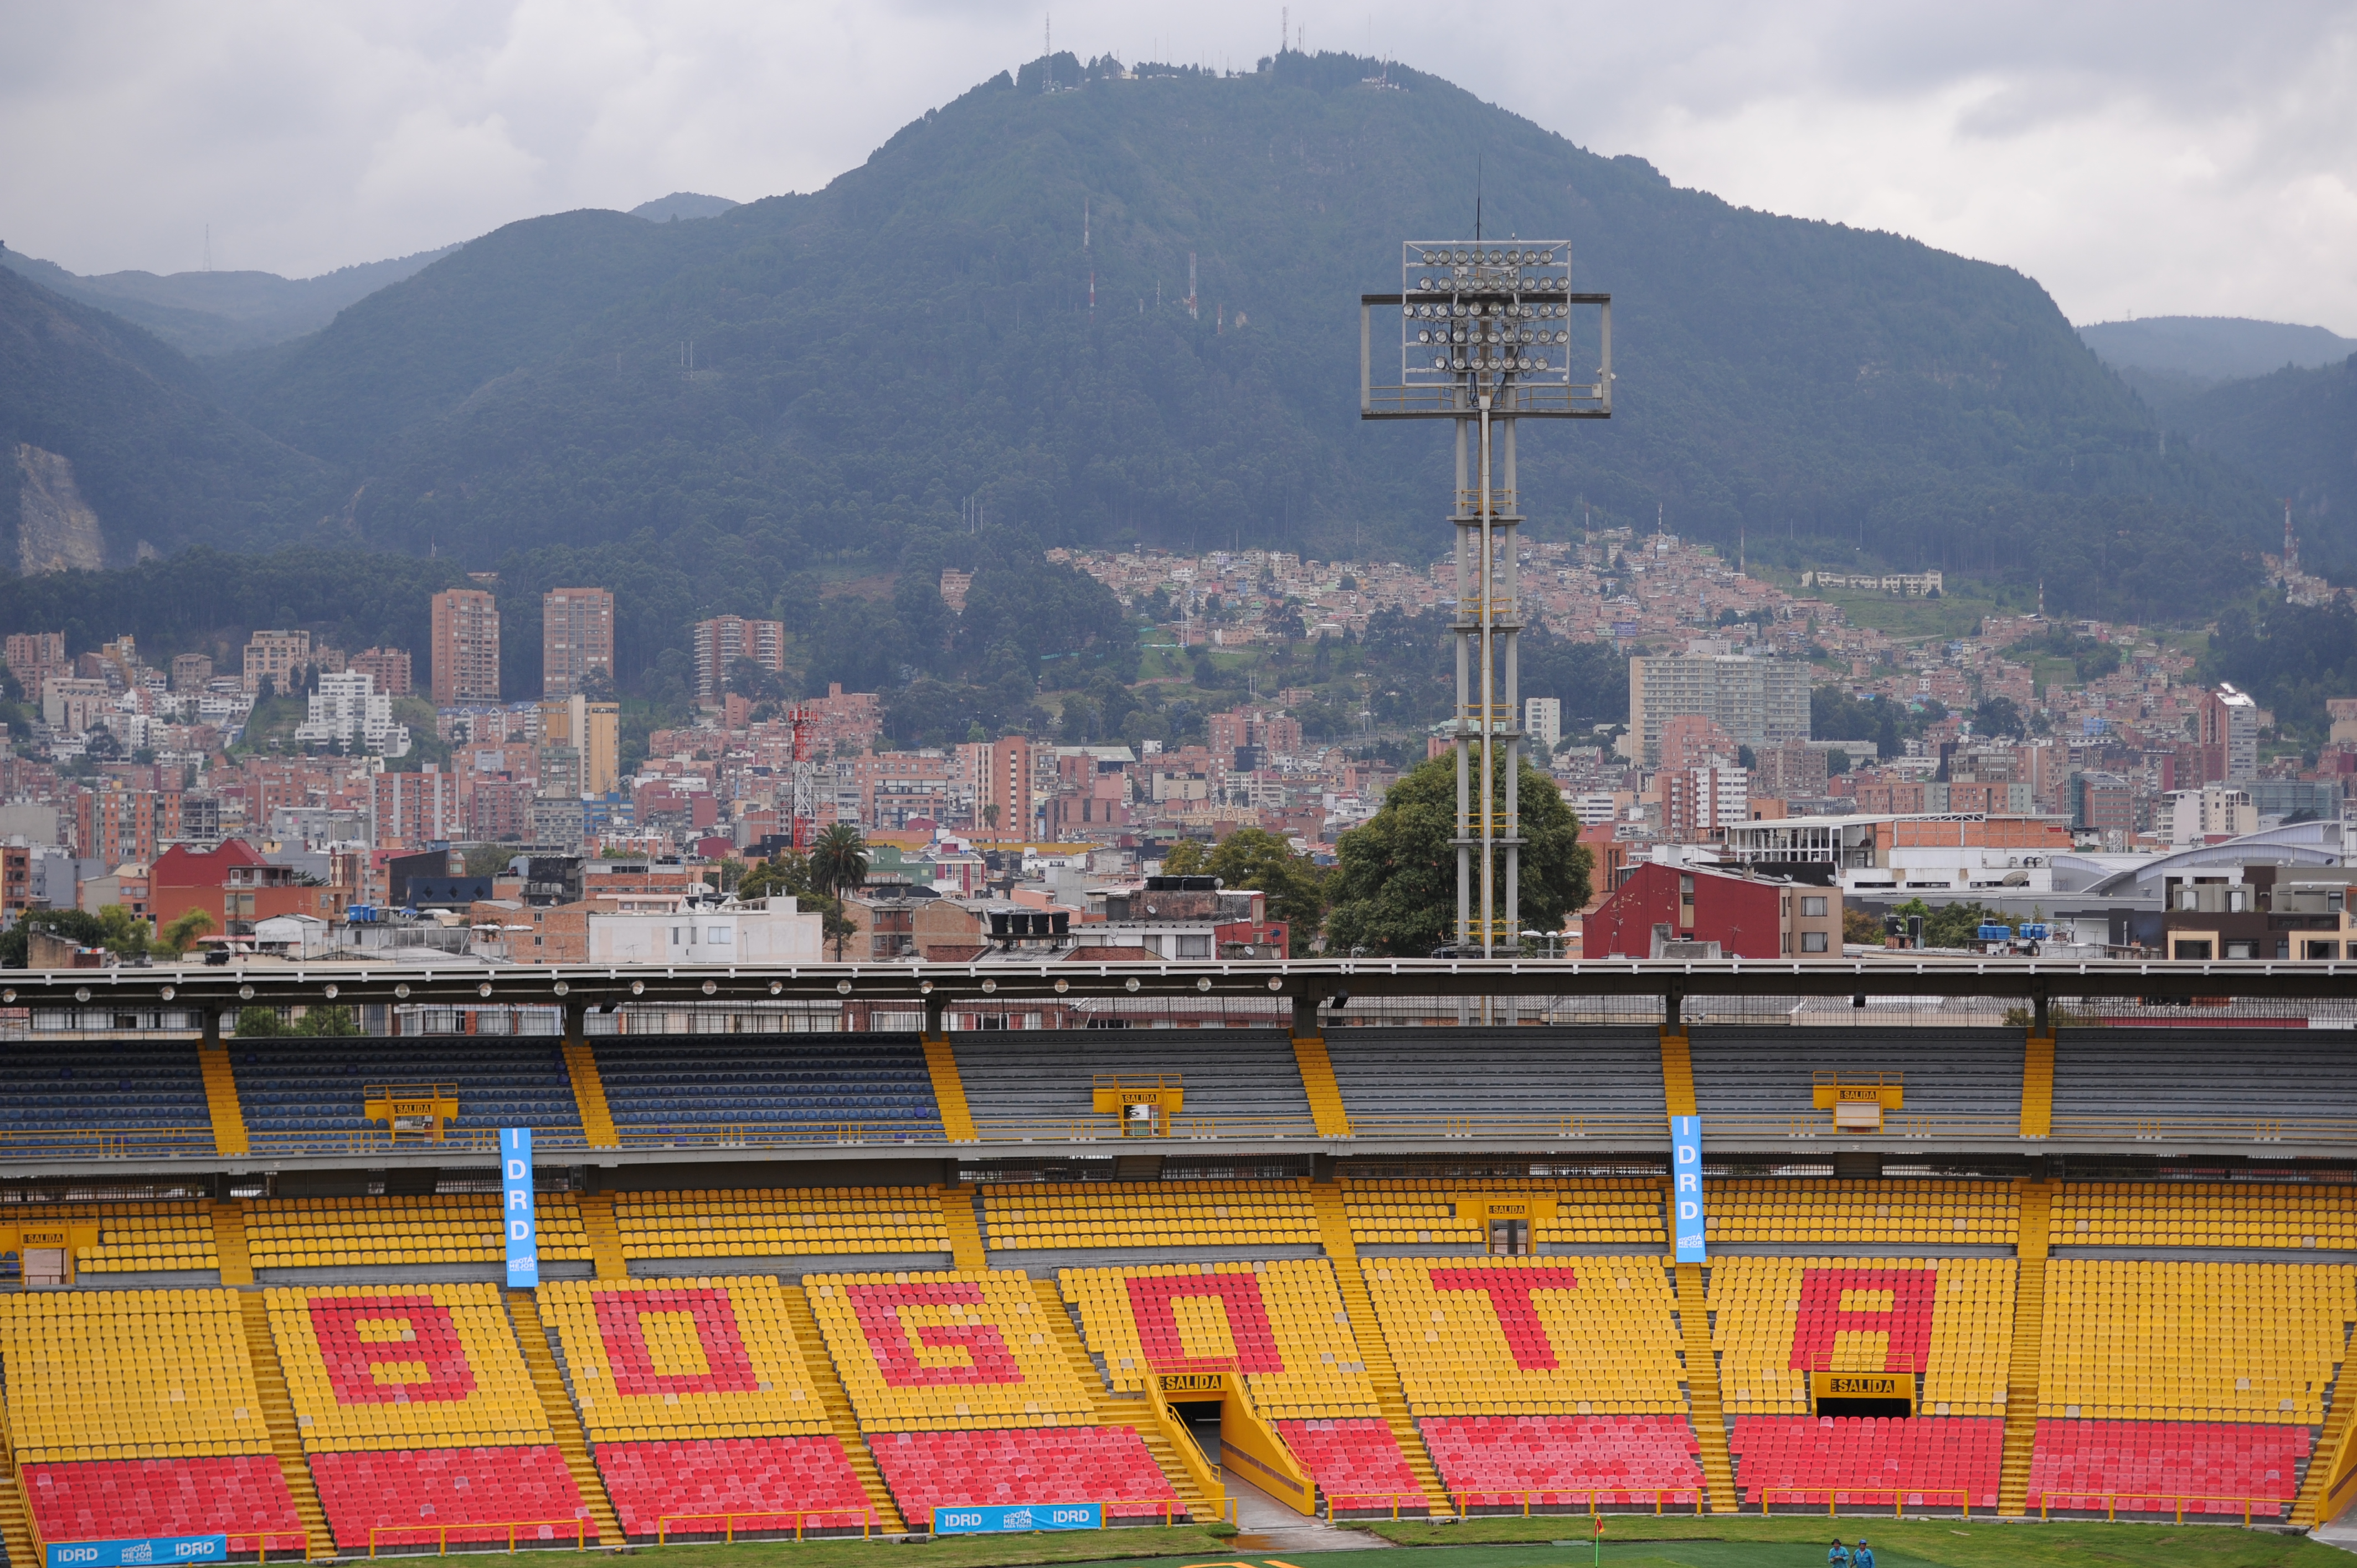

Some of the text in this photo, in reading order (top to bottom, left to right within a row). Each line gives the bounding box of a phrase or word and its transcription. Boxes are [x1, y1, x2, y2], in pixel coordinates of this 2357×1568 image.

[1125, 1094, 1155, 1102] SALIDA
[1844, 1091, 1875, 1099] SALIDA
[397, 1105, 430, 1113] SALIDA
[1678, 1117, 1699, 1220] IDRD
[507, 1128, 529, 1240] IDRD
[28, 1235, 63, 1244] SALIDA
[1166, 1375, 1221, 1390] SALIDA
[1838, 1379, 1893, 1392] SALIDA
[945, 1513, 982, 1527] IDRD
[1053, 1510, 1089, 1523] IDRD
[58, 1548, 98, 1562] IDRD
[176, 1541, 215, 1556] IDRD
[122, 1551, 152, 1560] MEJOR
